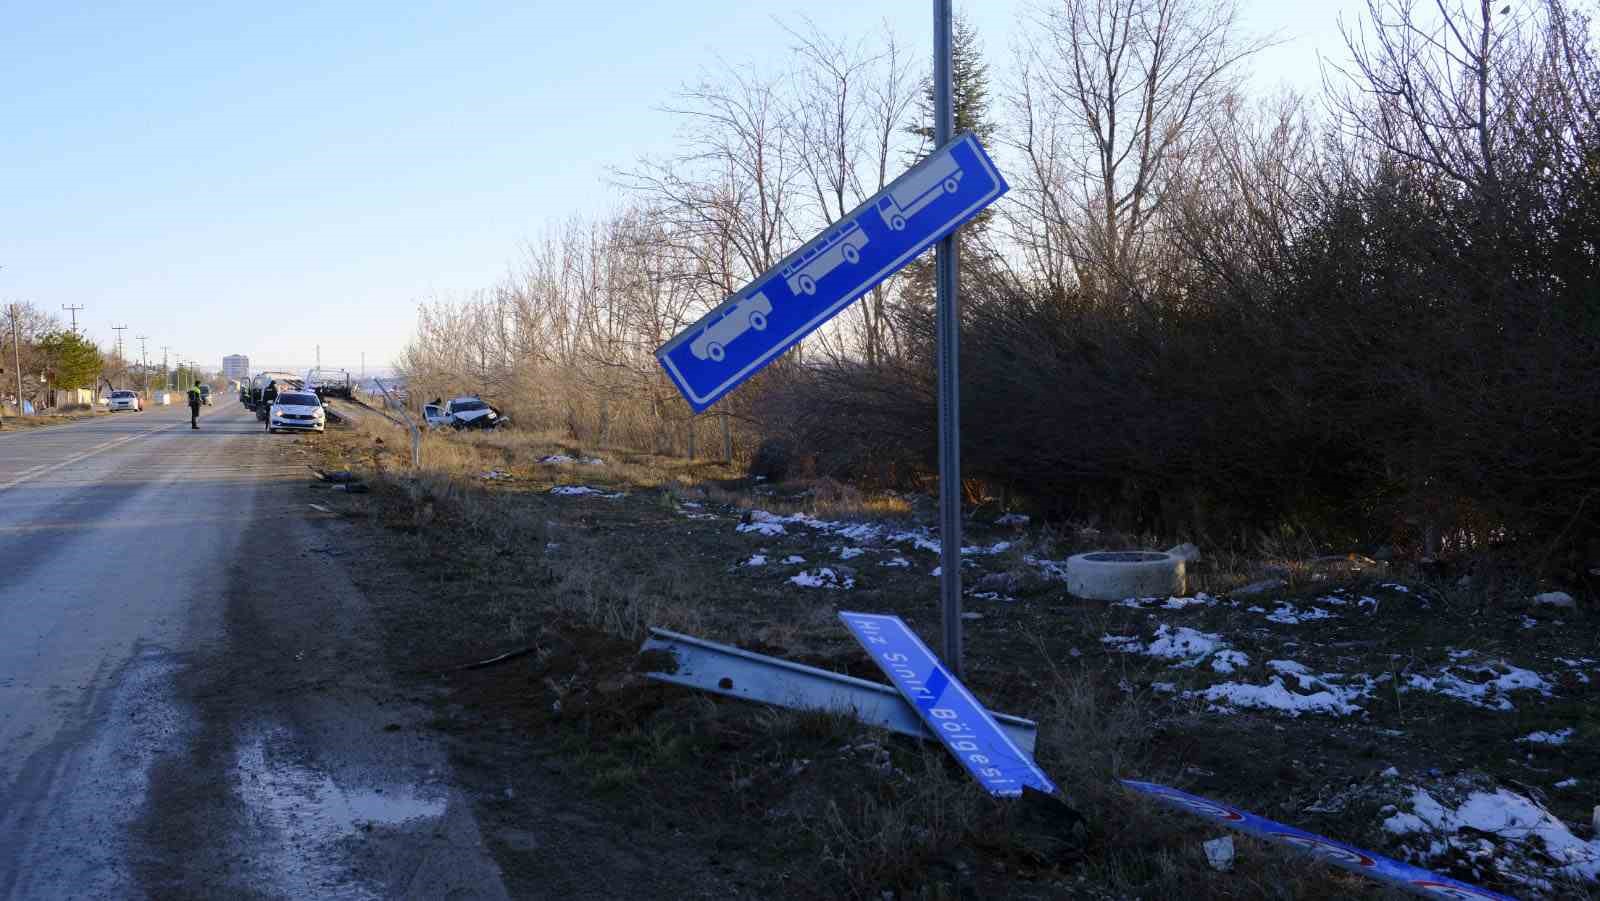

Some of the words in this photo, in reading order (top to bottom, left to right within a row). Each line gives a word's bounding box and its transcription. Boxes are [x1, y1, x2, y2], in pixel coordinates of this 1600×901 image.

[854, 621, 887, 644] Hız
[883, 652, 936, 699] Sınırı
[928, 708, 1015, 783] Bölgesi
